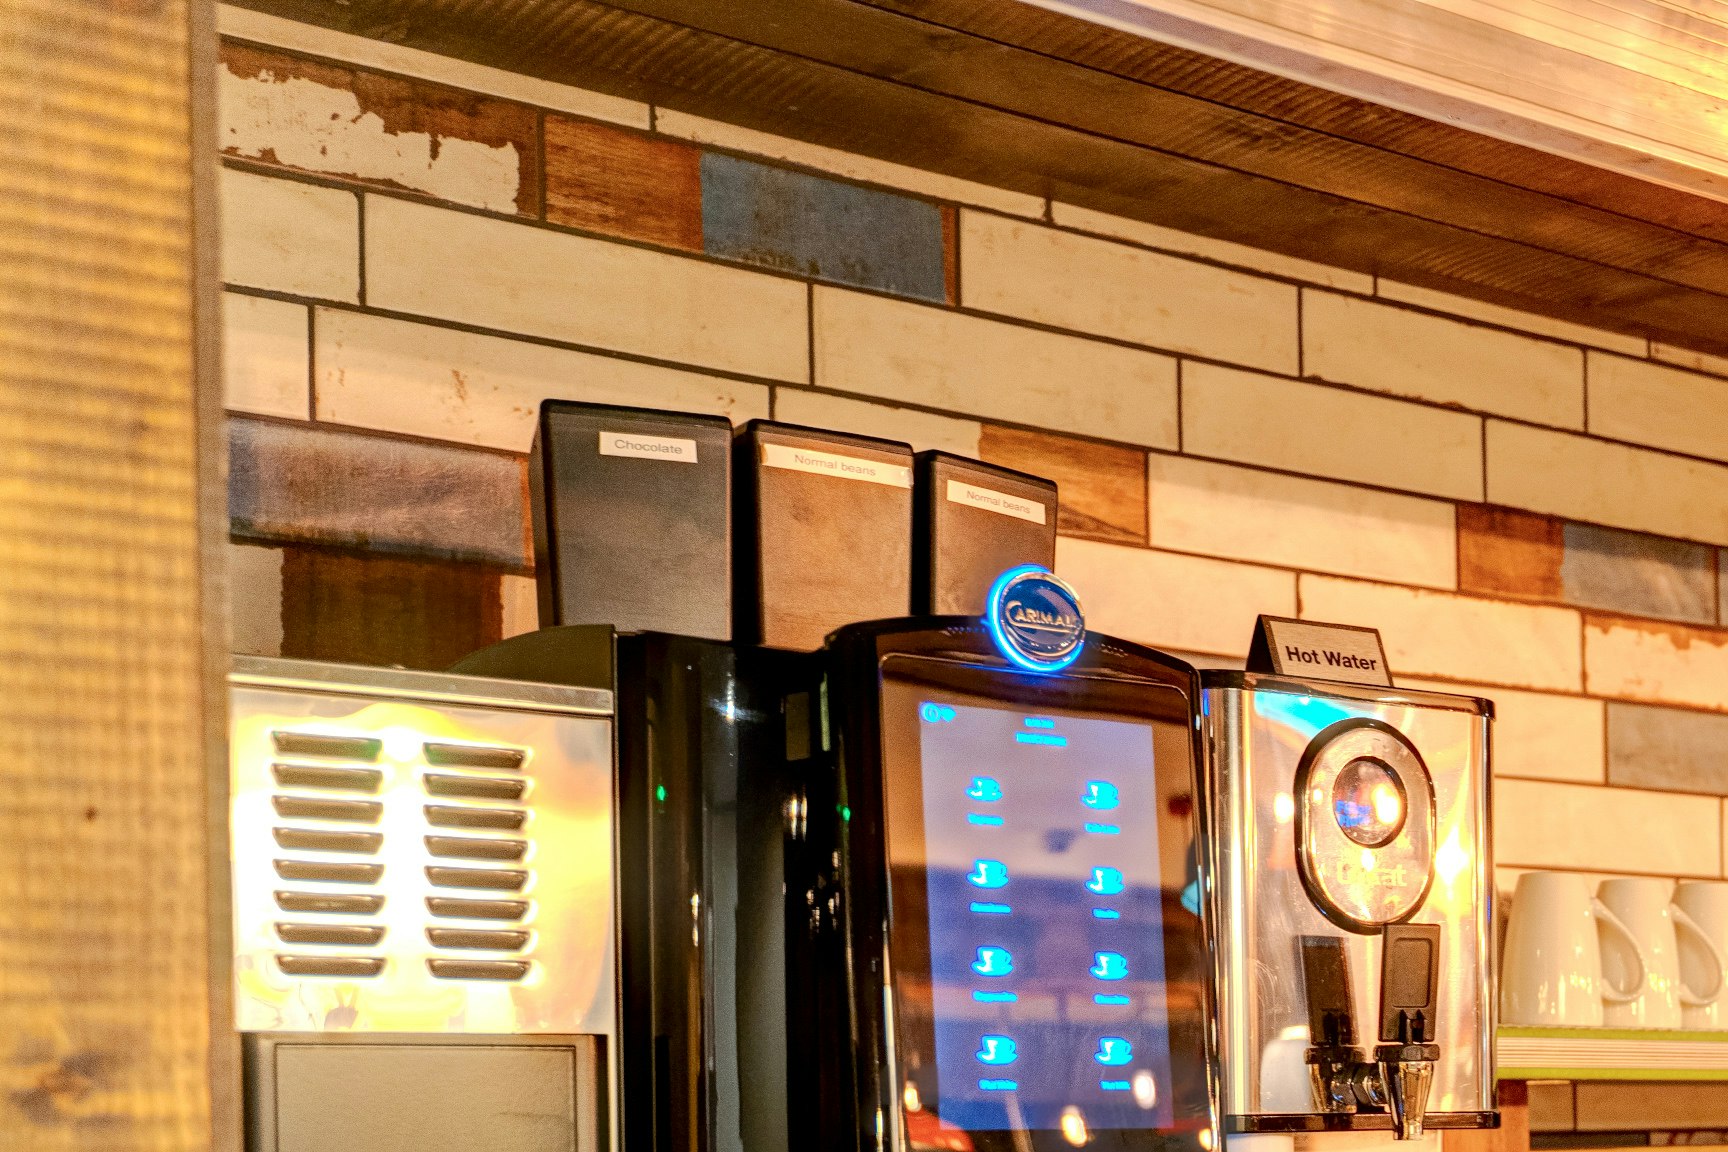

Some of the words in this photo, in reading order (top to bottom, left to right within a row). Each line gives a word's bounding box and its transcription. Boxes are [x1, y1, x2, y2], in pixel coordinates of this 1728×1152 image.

[614, 438, 683, 455] Chocolate
[794, 453, 838, 471] Normal
[841, 463, 877, 478] beans
[966, 489, 1001, 507] Normal
[1002, 499, 1032, 515] beans
[1285, 645, 1321, 665] Hot
[1323, 650, 1377, 671] Water
